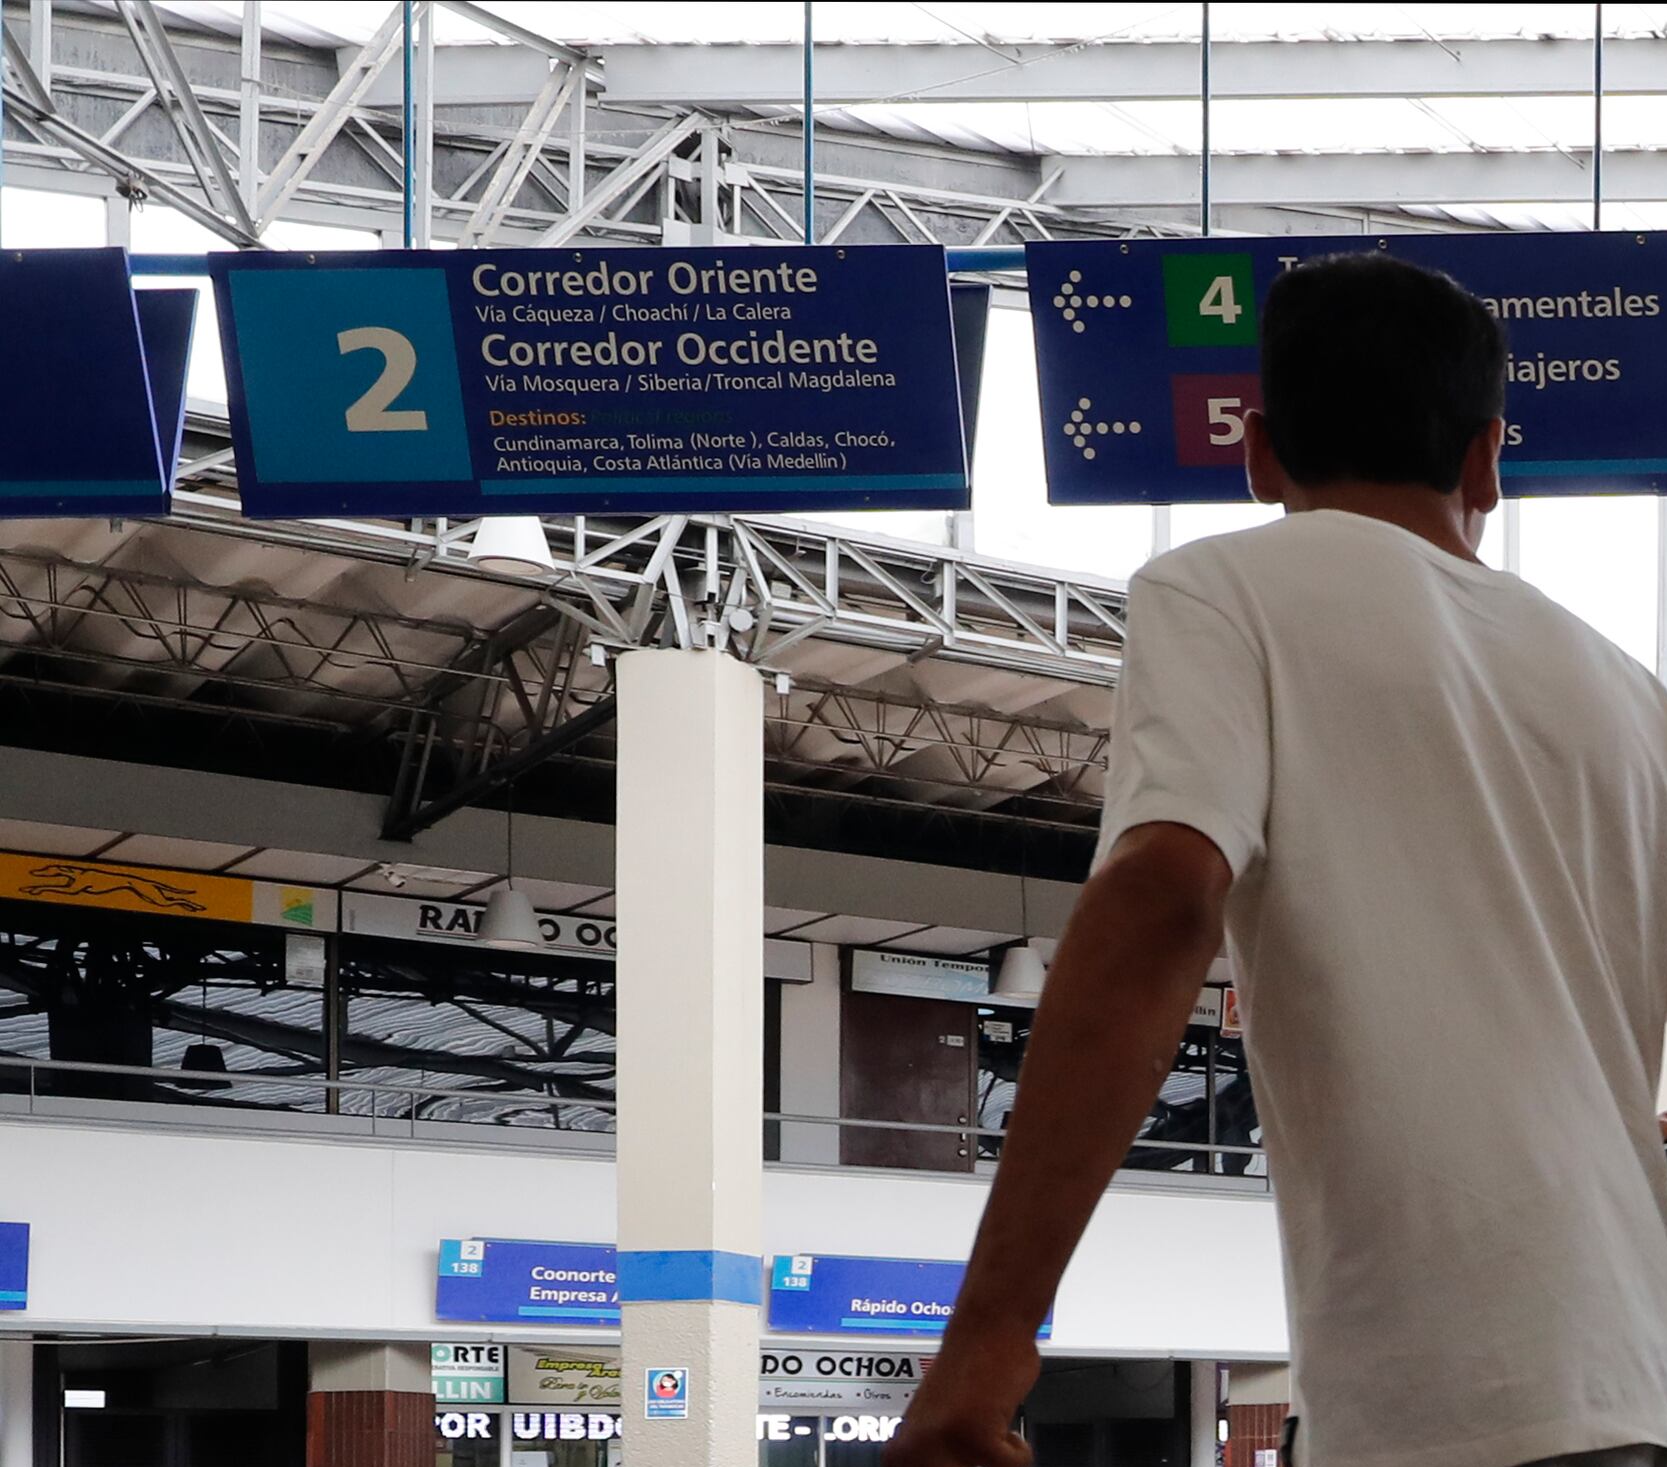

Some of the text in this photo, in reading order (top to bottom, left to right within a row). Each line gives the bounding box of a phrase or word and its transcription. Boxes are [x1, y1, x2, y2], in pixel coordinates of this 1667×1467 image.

[472, 260, 819, 297] Corredor Oriente
[1199, 276, 1243, 324] 4
[1484, 285, 1660, 320] amentales
[475, 304, 506, 323] Vía
[512, 303, 595, 326] Cáqueza
[613, 302, 689, 322] Choachí
[706, 304, 727, 321] La
[733, 302, 792, 321] Calera
[481, 330, 879, 367] Corredor Occidente
[336, 326, 428, 433] 2
[485, 374, 517, 392] Vía
[523, 373, 620, 396] Mosquera
[789, 370, 897, 393] Magdalena
[1504, 354, 1622, 390] iajeros
[490, 410, 587, 427] Destinos:
[1206, 398, 1245, 447] 5
[493, 435, 626, 453] Cundinamarca,
[627, 434, 684, 451] Tolima
[690, 433, 747, 452] (Norte
[767, 431, 830, 450] Caldas,
[496, 456, 588, 474] Antioquia,
[592, 455, 642, 472] Costa
[646, 453, 723, 471] Atlántica
[728, 452, 762, 472] (Vía
[467, 1245, 478, 1256] 2
[451, 1262, 479, 1274] 138
[531, 1266, 617, 1284] Coonorte
[798, 1261, 807, 1270] 2
[783, 1277, 807, 1288] 138
[529, 1286, 608, 1304] Empresa
[850, 1298, 908, 1316] Rápido
[432, 1344, 500, 1364] ORTE
[536, 1358, 603, 1372] Empresa
[760, 1354, 915, 1378] DO OCHOA
[774, 1387, 843, 1399] Encomiendas
[434, 1412, 492, 1439] OR
